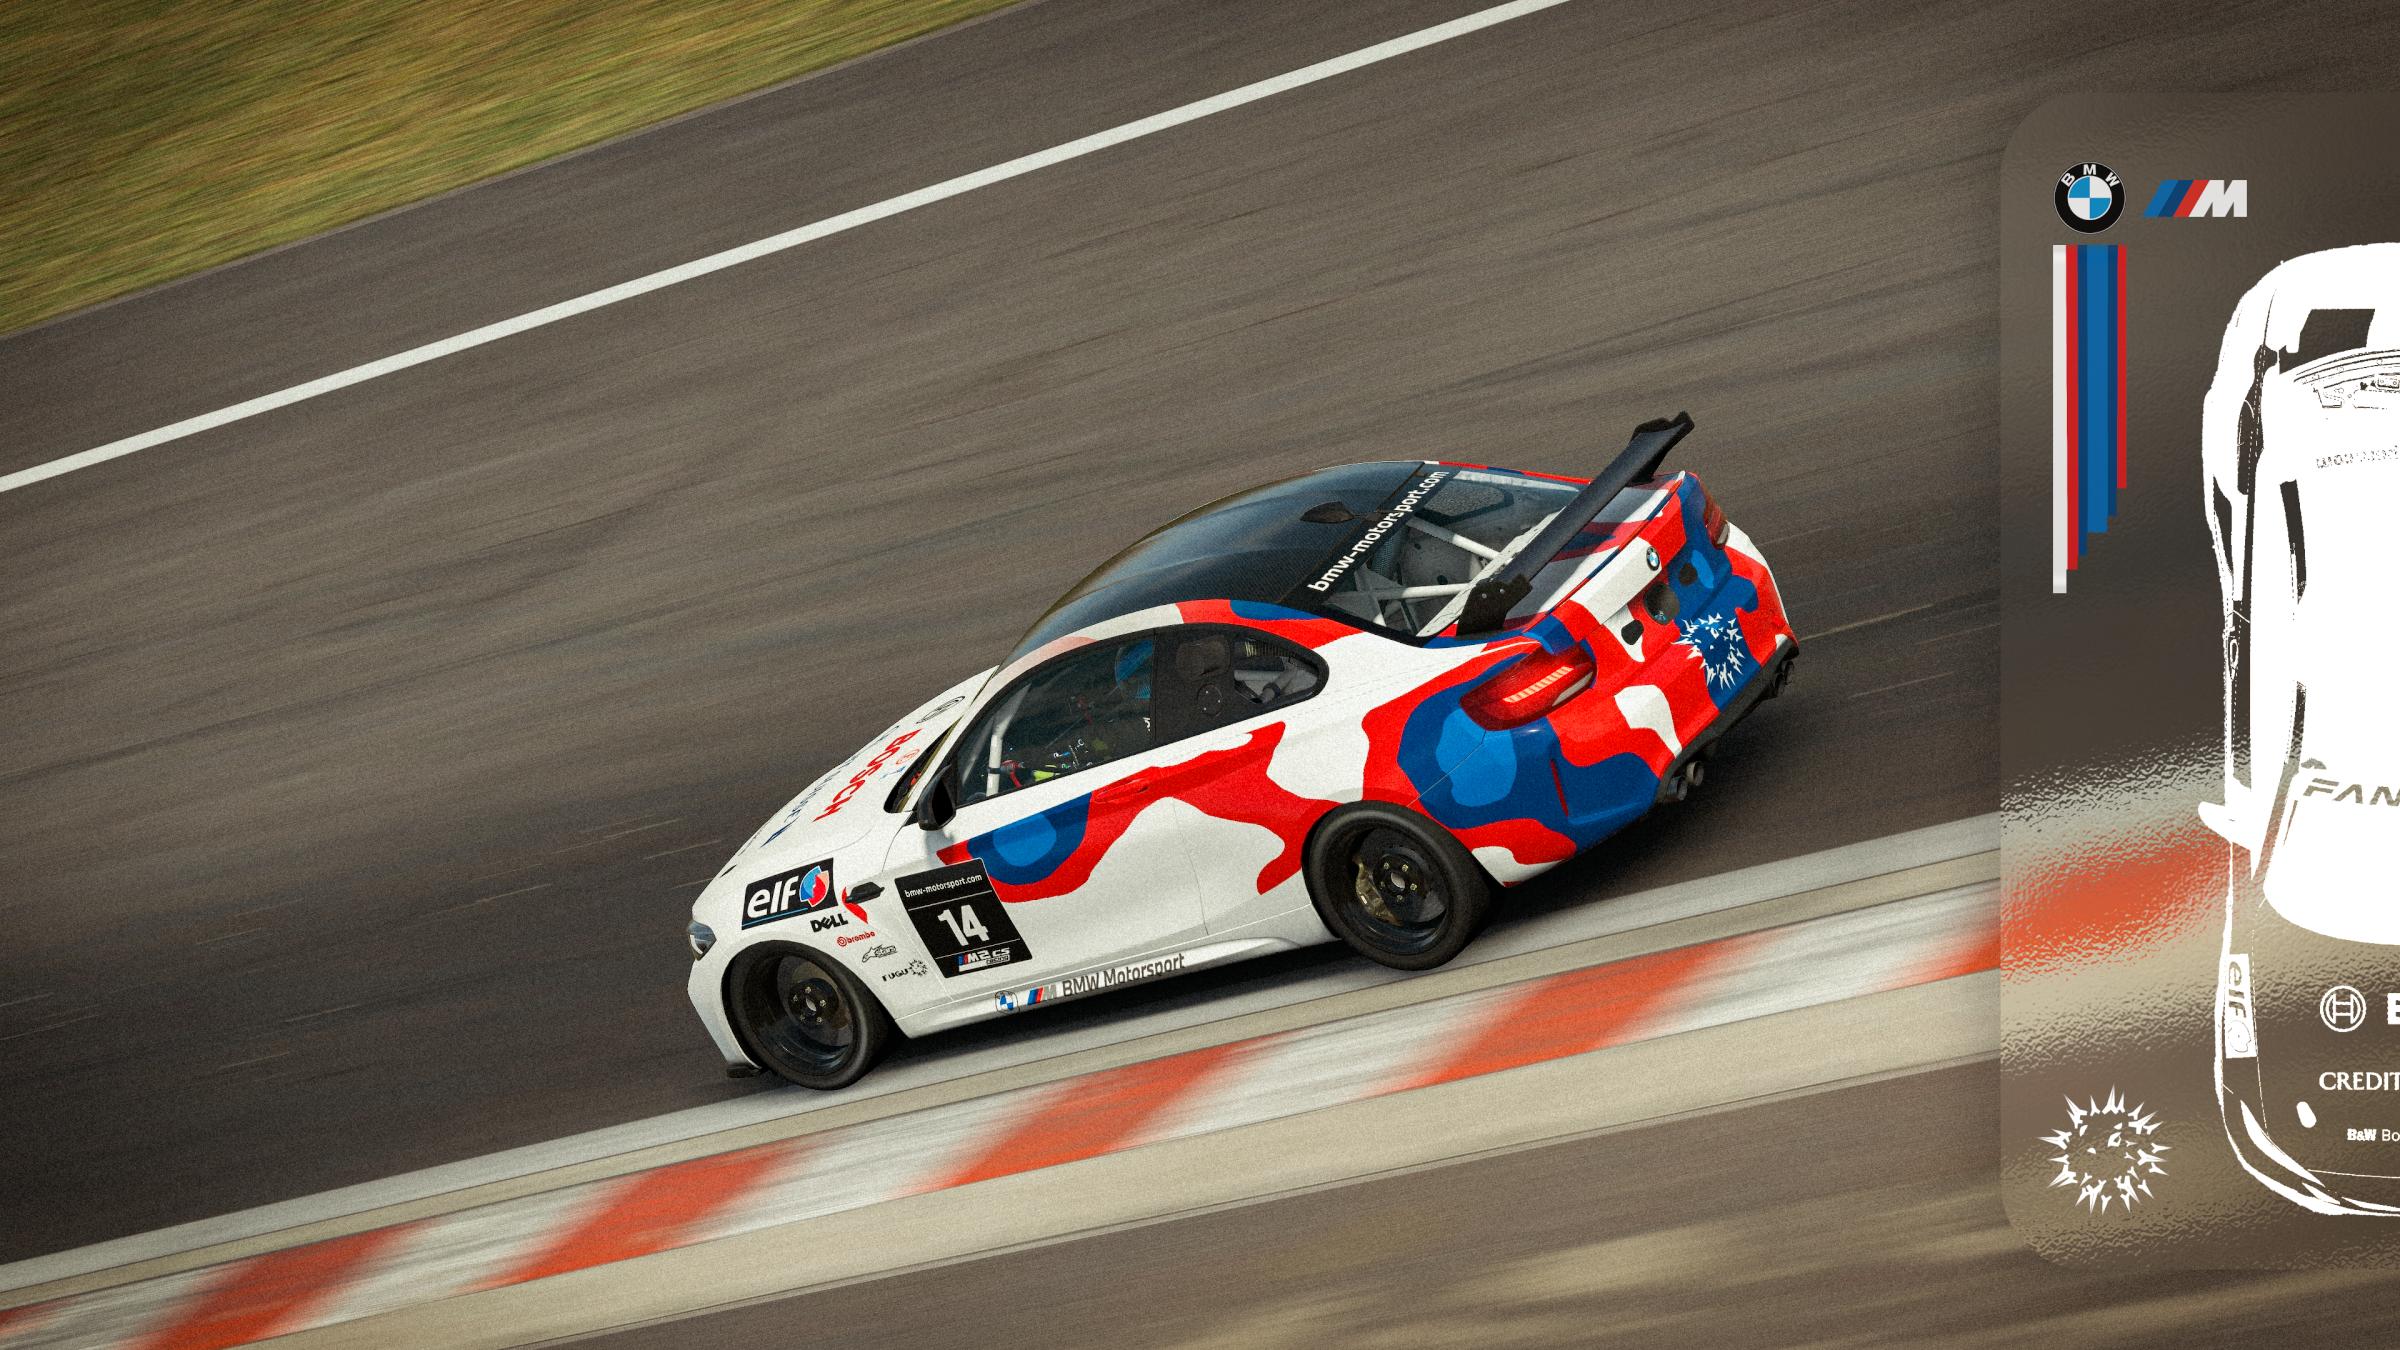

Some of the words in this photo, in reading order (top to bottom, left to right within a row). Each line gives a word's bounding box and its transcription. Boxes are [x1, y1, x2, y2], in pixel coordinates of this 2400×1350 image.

[1306, 470, 1450, 592] bmw-motorsport.com
[811, 728, 924, 823] BOSCH
[747, 875, 799, 919] elf
[904, 873, 983, 898] bmw-motorsport.com
[809, 912, 849, 933] DELL
[846, 930, 876, 945] brembo
[937, 904, 990, 947] 14
[1062, 972, 1100, 997] BMW
[1103, 952, 1185, 988] Motorsport
